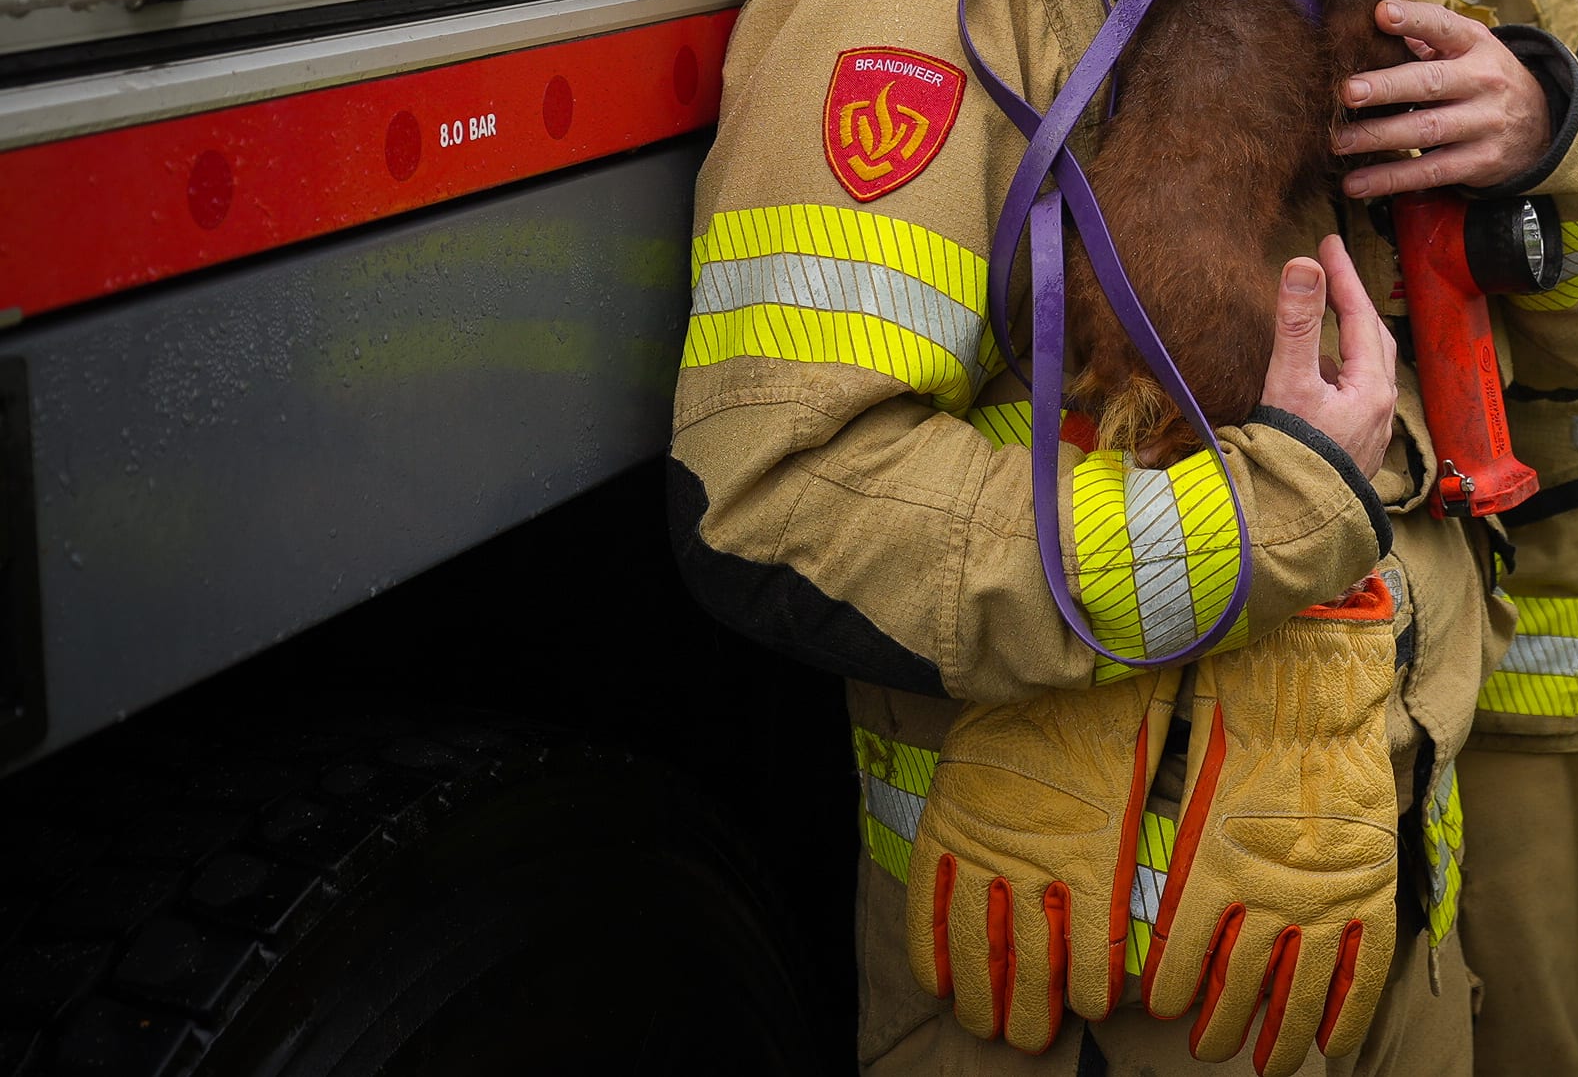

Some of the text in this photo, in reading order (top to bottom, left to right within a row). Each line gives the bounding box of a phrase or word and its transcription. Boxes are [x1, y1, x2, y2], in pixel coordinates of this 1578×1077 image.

[855, 59, 944, 87] BRANDWEER
[440, 113, 497, 148] 8.0 BAR
